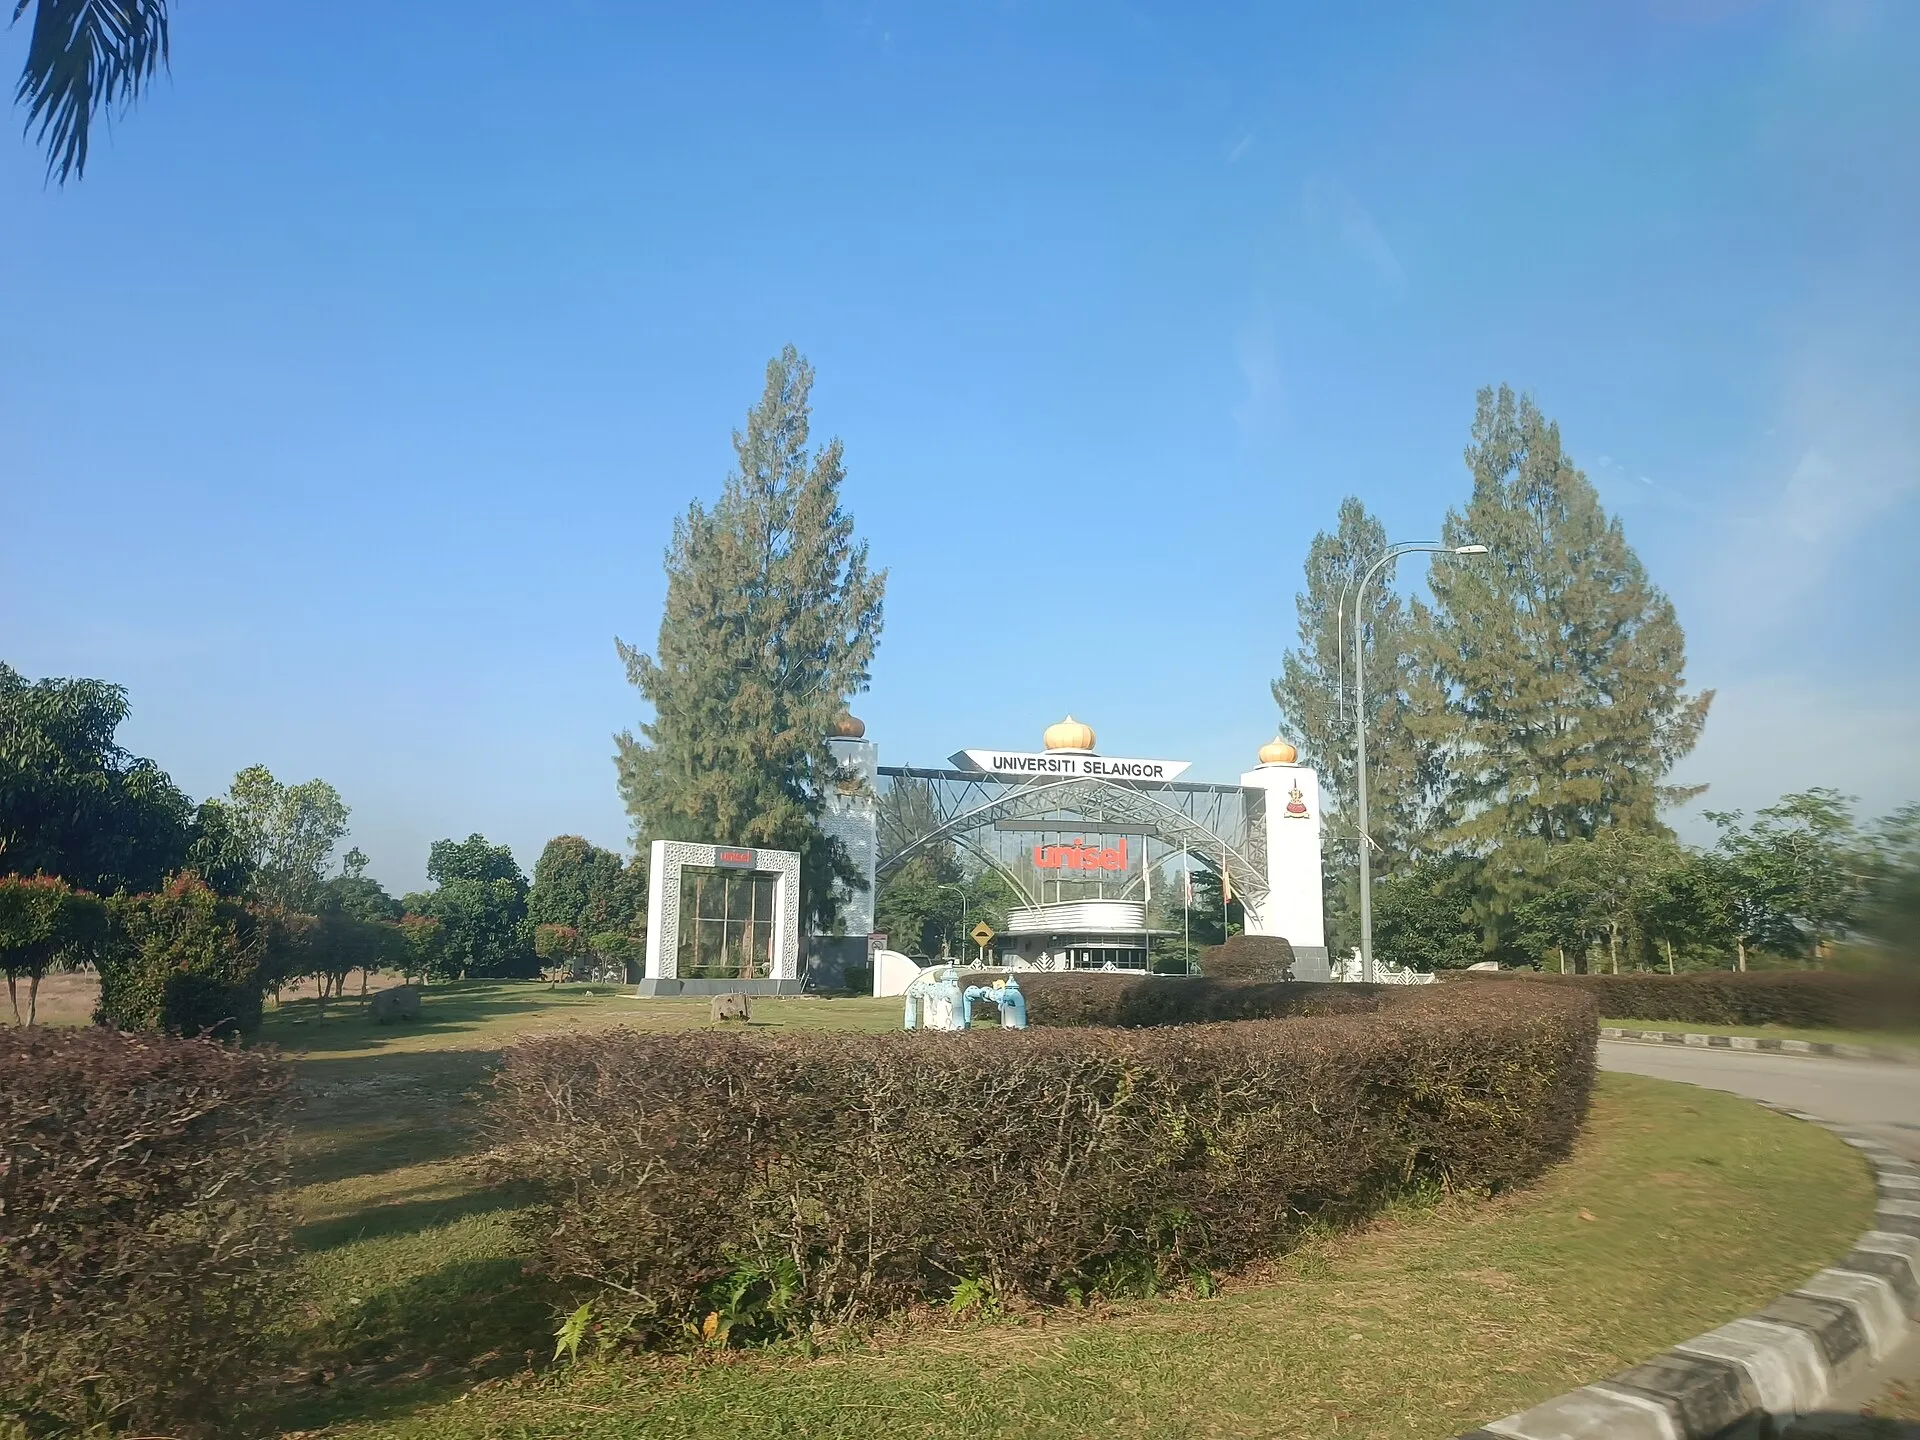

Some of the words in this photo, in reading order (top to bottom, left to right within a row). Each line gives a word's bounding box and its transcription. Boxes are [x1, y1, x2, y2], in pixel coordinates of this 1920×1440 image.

[993, 756, 1075, 773] UNIVERSITI
[1083, 761, 1163, 778] SELANGOR
[1034, 838, 1127, 870] unisel
